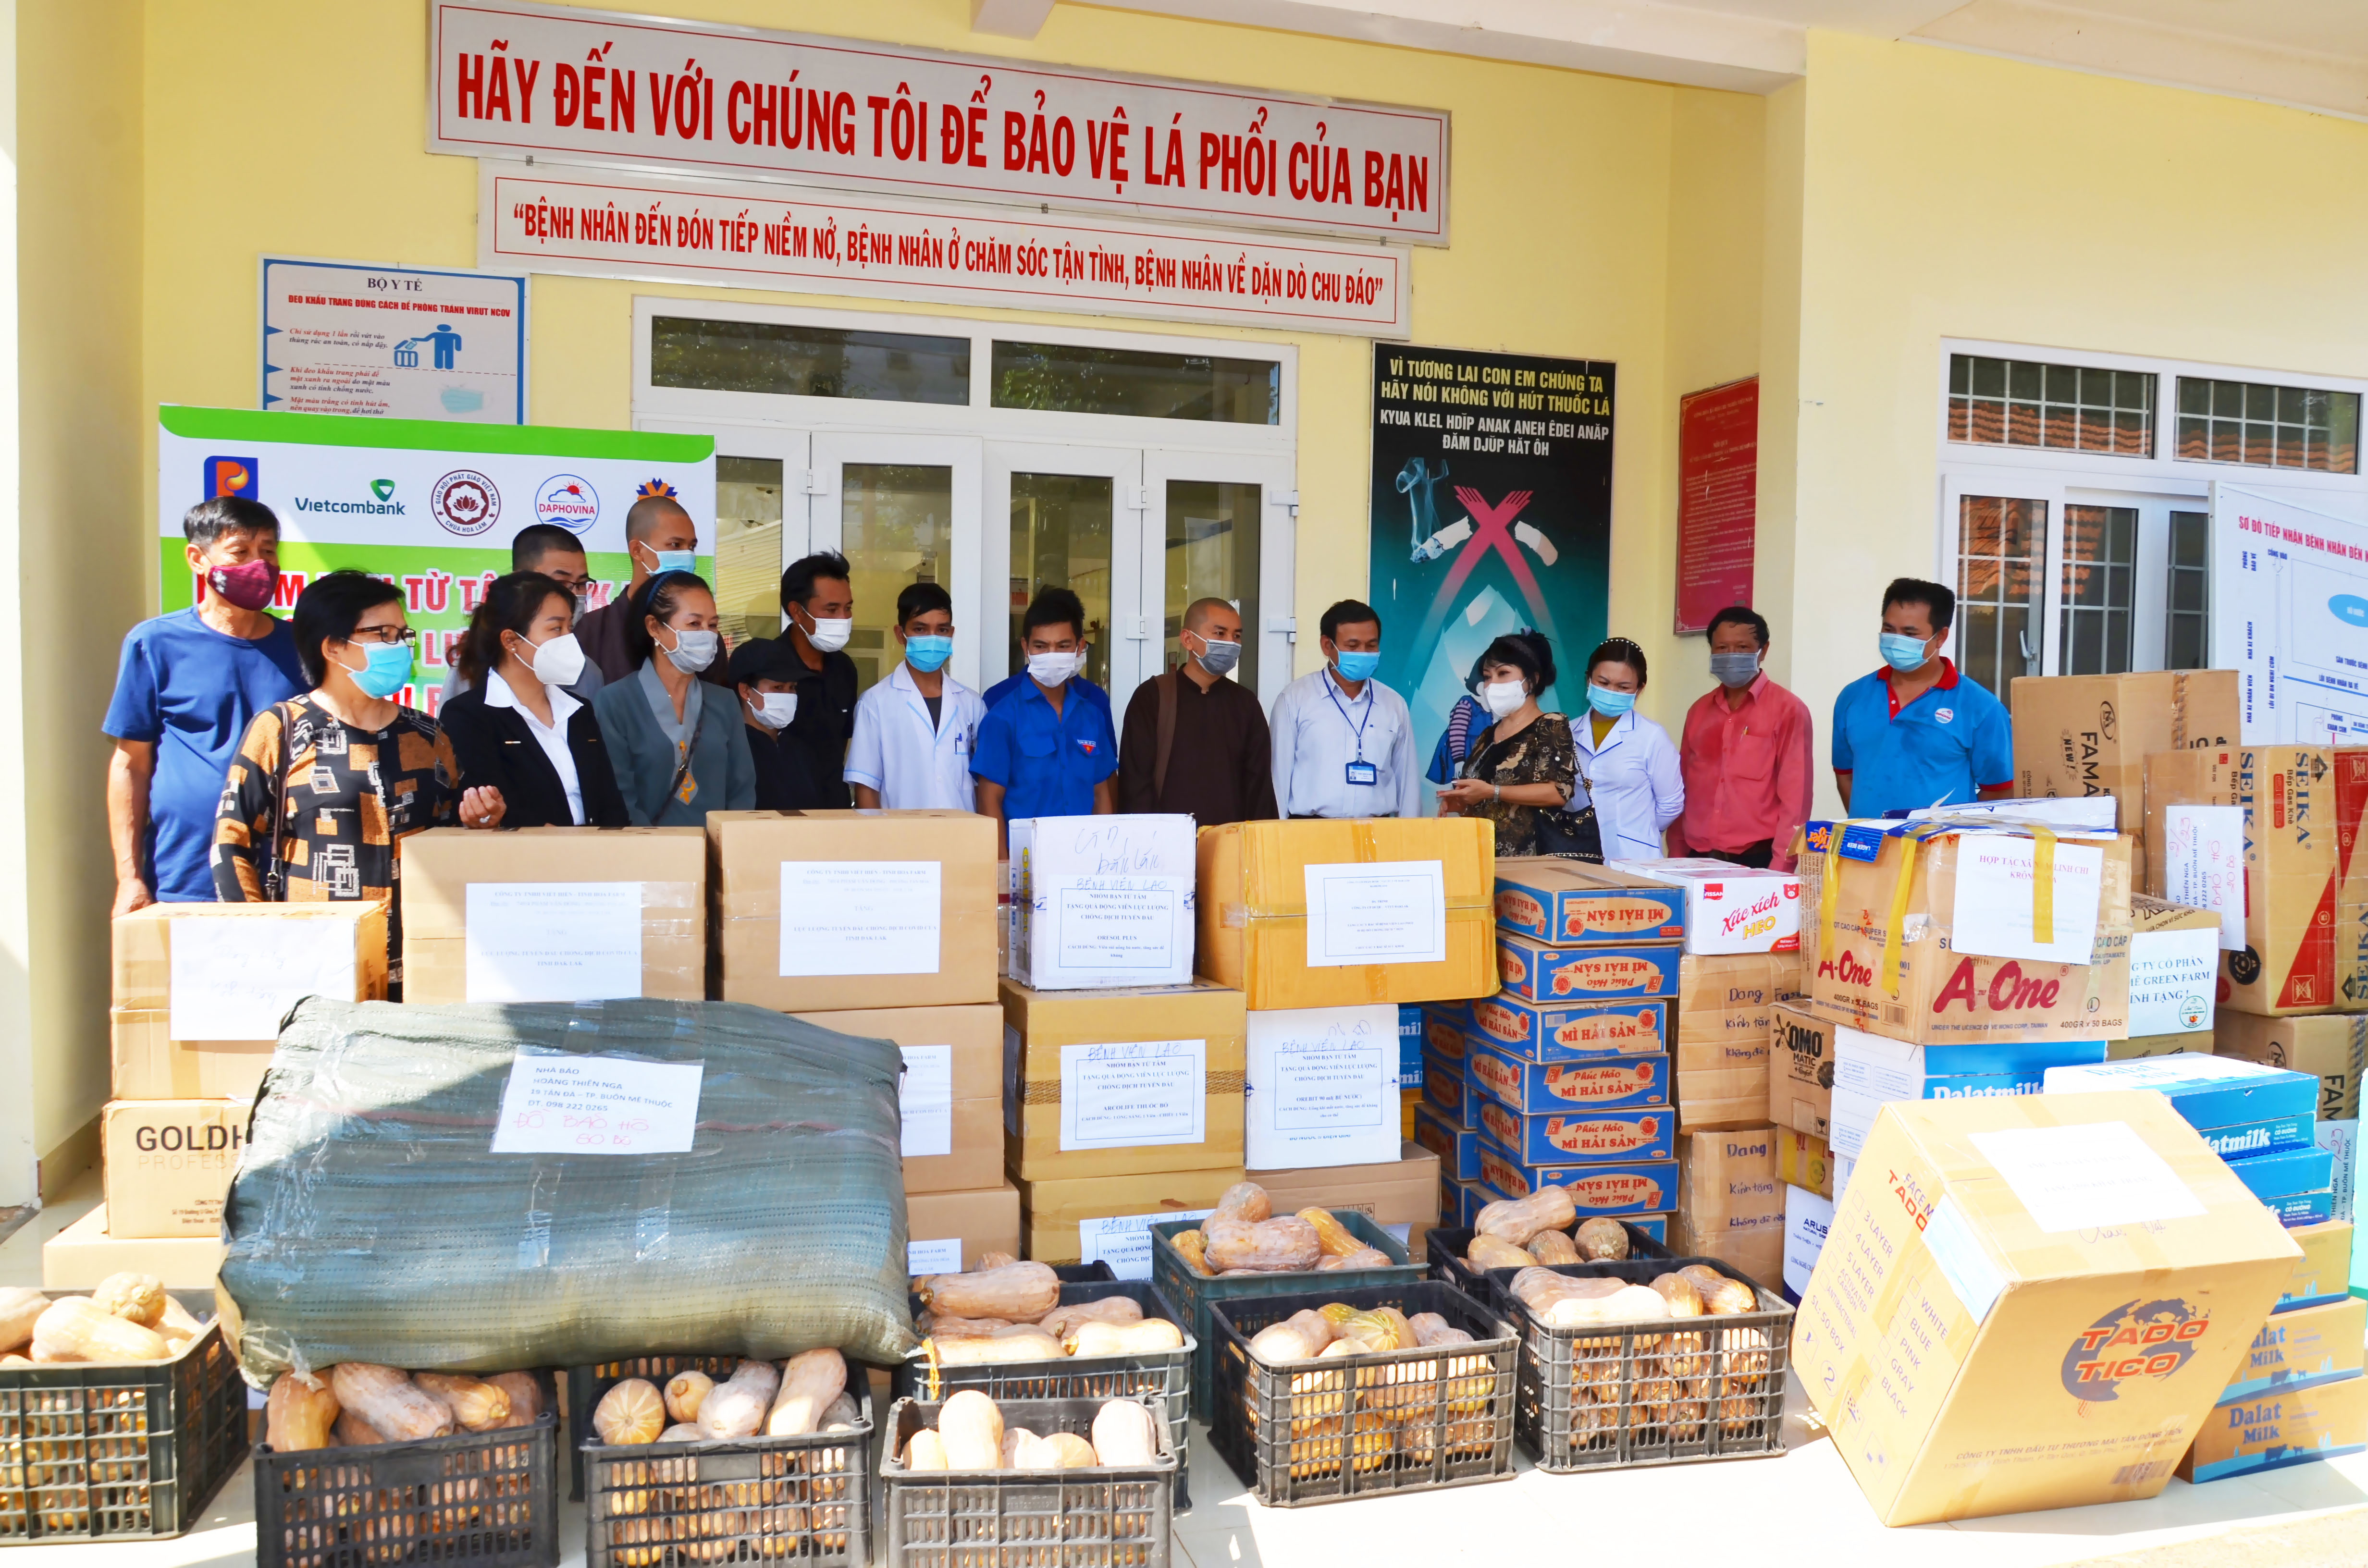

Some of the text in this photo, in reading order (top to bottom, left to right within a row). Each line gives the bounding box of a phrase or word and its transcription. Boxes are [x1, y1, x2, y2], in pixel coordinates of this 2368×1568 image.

[458, 39, 1428, 222] HÃY ĐẾN VỚI CHÚNG TÔI ĐỂ BẢO VỆ LÁ PHỔI CỦA BẠN
[514, 196, 1383, 305] “BỆNH NHÂN ĐẾN ĐÓN TIẾP NIỀM NỞ, BỆNH NHÂN Ở CHĂM SÓC TẬN TÌNH, BỆNH NHÂN VỀ DẶN DÒ CHU ĐÁO”
[368, 277, 422, 291] BỘ Y TẾ
[288, 294, 510, 317] ĐEO KHẨU TRANG ĐÚNG CÁCH ĐỂ PHÒNG TRÁNH VIRUT NCOV
[1390, 356, 1603, 392] VÌ TƯƠNG LAI CON EM CHÚNG TA
[1381, 379, 1609, 415] HÃY NÓI KHÔNG VỚI HÚT THUỐC LÁ
[1381, 409, 1608, 440] KYUA KLEL HDĬP ANAK ANEH ÊDEI ANĂP
[1443, 432, 1549, 455] ĐĂM DJŬP HĂT ÔH
[295, 497, 406, 515] Vietcombank
[539, 503, 595, 514] DAPHOVINA
[405, 572, 450, 611] TỪ
[2063, 739, 2076, 770] NEW!
[2240, 753, 2254, 852] SEIKA
[2295, 753, 2310, 844] SEIKA
[1722, 892, 1780, 936] Xúc xích
[1743, 916, 1776, 940] HEO
[1818, 950, 1872, 987] A-One
[2144, 971, 2209, 985] GREEN FARM
[1933, 956, 2060, 1013] A-One
[1789, 1025, 1822, 1058] OMO
[1574, 1069, 1620, 1081] Phúc Hảo
[1793, 1053, 1816, 1066] MATIC
[533, 1078, 568, 1086] HOÀNG
[1561, 1081, 1634, 1096] MÌ HẢI SẢN
[644, 1098, 673, 1107] THUỘC
[1562, 1134, 1637, 1149] MÌ HẢI SẢN
[1575, 1123, 1623, 1133] Phúc Hảo
[1864, 1210, 1892, 1258] 3 LAYER
[1921, 1297, 1948, 1340] WHITE
[1911, 1318, 1932, 1352] BLUE
[2082, 1320, 2209, 1350] TADO
[1900, 1337, 1921, 1371] PINK
[2078, 1354, 2178, 1382] TICO
[1891, 1359, 1914, 1393] GRAY
[1882, 1377, 1907, 1419] BLACK
[2229, 1402, 2282, 1429] Dalat
[2242, 1425, 2280, 1445] Milk
